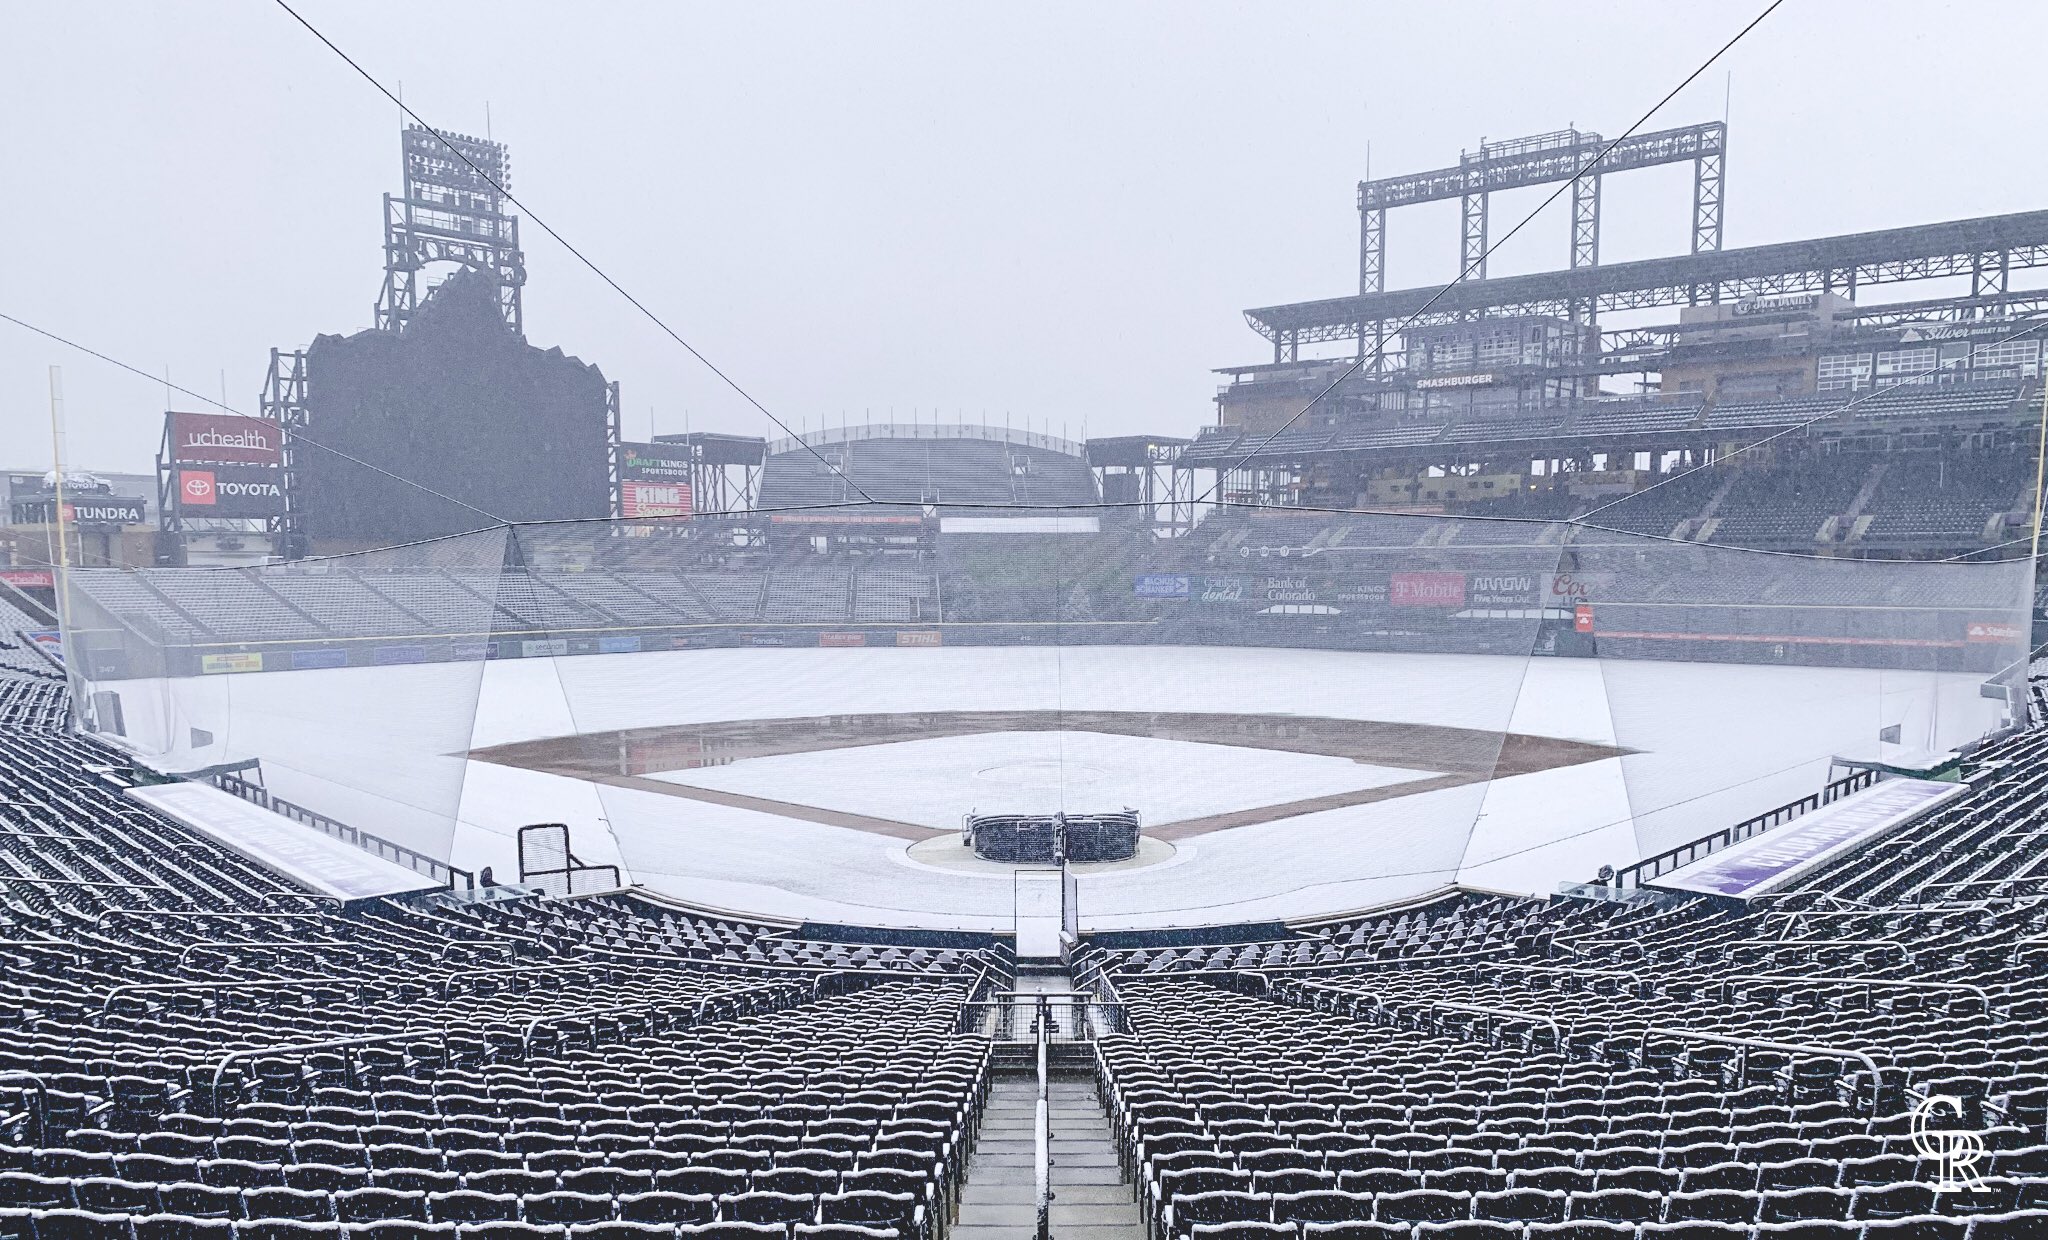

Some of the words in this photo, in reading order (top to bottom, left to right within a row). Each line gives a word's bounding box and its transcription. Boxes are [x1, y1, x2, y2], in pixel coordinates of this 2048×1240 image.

[1925, 325, 1970, 341] Silver
[1416, 374, 1493, 389] SMASHBURGER
[188, 427, 268, 450] uchealth
[626, 458, 689, 469] DRAFTKINGS
[641, 467, 688, 476] SPORTSBOOK
[66, 482, 99, 490] TOYOTA
[216, 482, 281, 497] TOYOTA
[635, 487, 681, 504] KING
[73, 506, 140, 520] TUNDRA
[8, 573, 49, 585] chealth
[1267, 577, 1294, 589] Bank
[1295, 577, 1308, 588] of
[1473, 576, 1532, 591] ARROW
[1201, 586, 1243, 602] dental
[1267, 588, 1316, 601] Colorado
[1473, 593, 1491, 603] Five
[1492, 593, 1514, 603] Years
[1514, 593, 1529, 603] Out
[901, 634, 939, 644] STIHL
